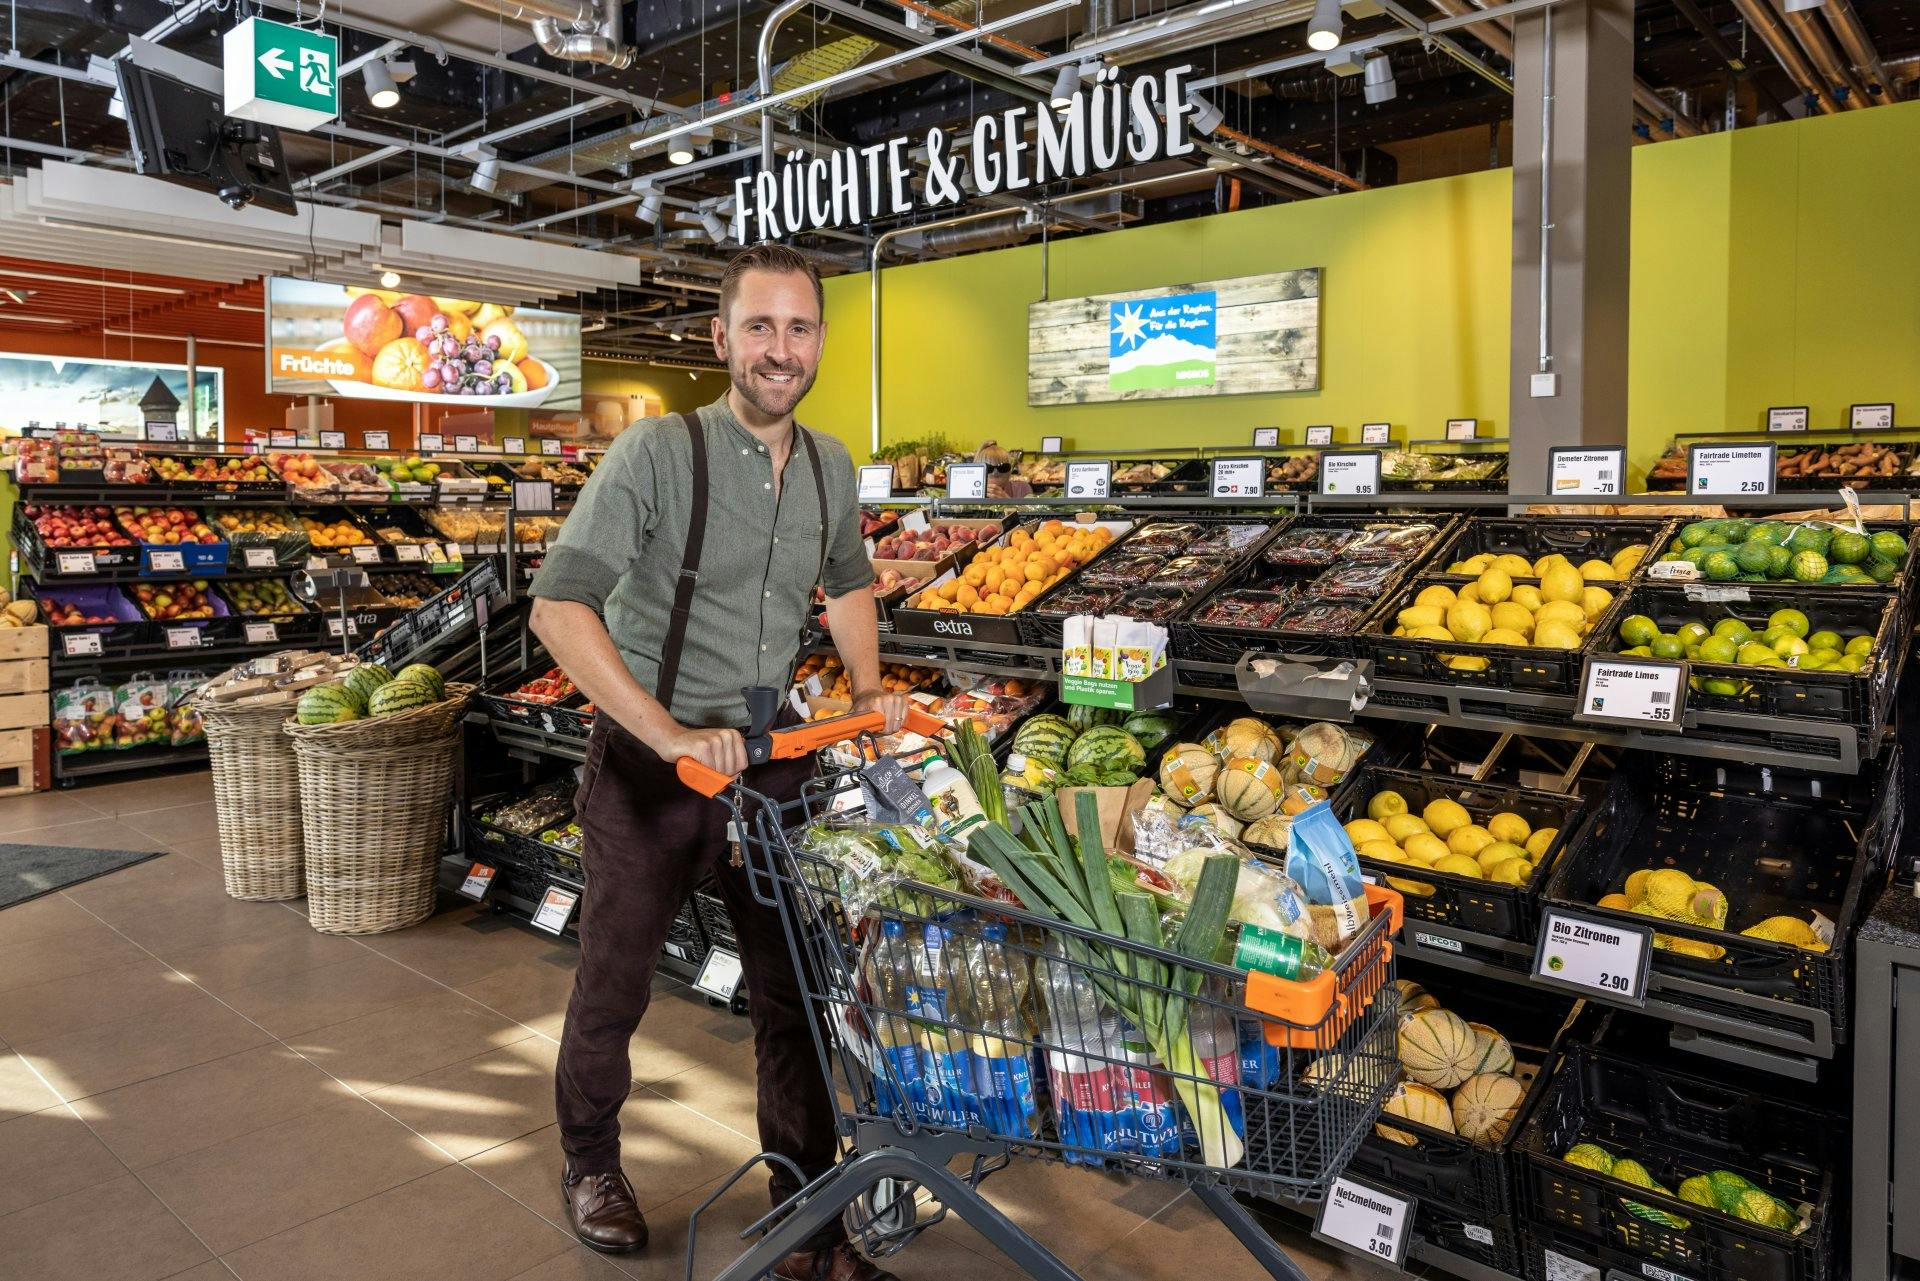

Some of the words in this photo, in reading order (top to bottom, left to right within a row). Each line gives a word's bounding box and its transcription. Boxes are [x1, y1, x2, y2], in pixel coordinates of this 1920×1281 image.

[734, 136, 914, 246] FRÜCHTE
[925, 126, 962, 206] &
[973, 63, 1197, 194] GEMÜSE
[1150, 308, 1166, 318] Aus
[1167, 306, 1181, 316] der
[1165, 320, 1177, 329] die
[281, 354, 355, 376] Früchte
[1557, 455, 1583, 463] Demeter
[1583, 454, 1609, 462] Zitronen
[1700, 452, 1730, 460] Fairtrade
[1731, 451, 1762, 460] Limetten
[1093, 488, 1105, 496] 7.95
[1244, 486, 1258, 495] 7.90
[1356, 485, 1372, 494] 9.95
[1741, 481, 1764, 492] 2.50
[355, 612, 377, 625] tra
[933, 619, 973, 636] extra
[1597, 668, 1633, 679] Fairtrade
[1634, 670, 1660, 680] Limes
[1064, 677, 1083, 686] Veggie
[1083, 679, 1098, 688] Bags
[1076, 685, 1095, 693] Plastik
[1096, 688, 1117, 696] sparen.
[1323, 861, 1358, 942] albweissmehl
[1553, 921, 1571, 935] Bio
[1573, 925, 1620, 946] Zitronen
[1429, 935, 1449, 946] IFCO
[1599, 972, 1629, 991] 2.90
[1336, 1187, 1393, 1216] Netzmelonen
[1369, 1238, 1392, 1258] 3.90
